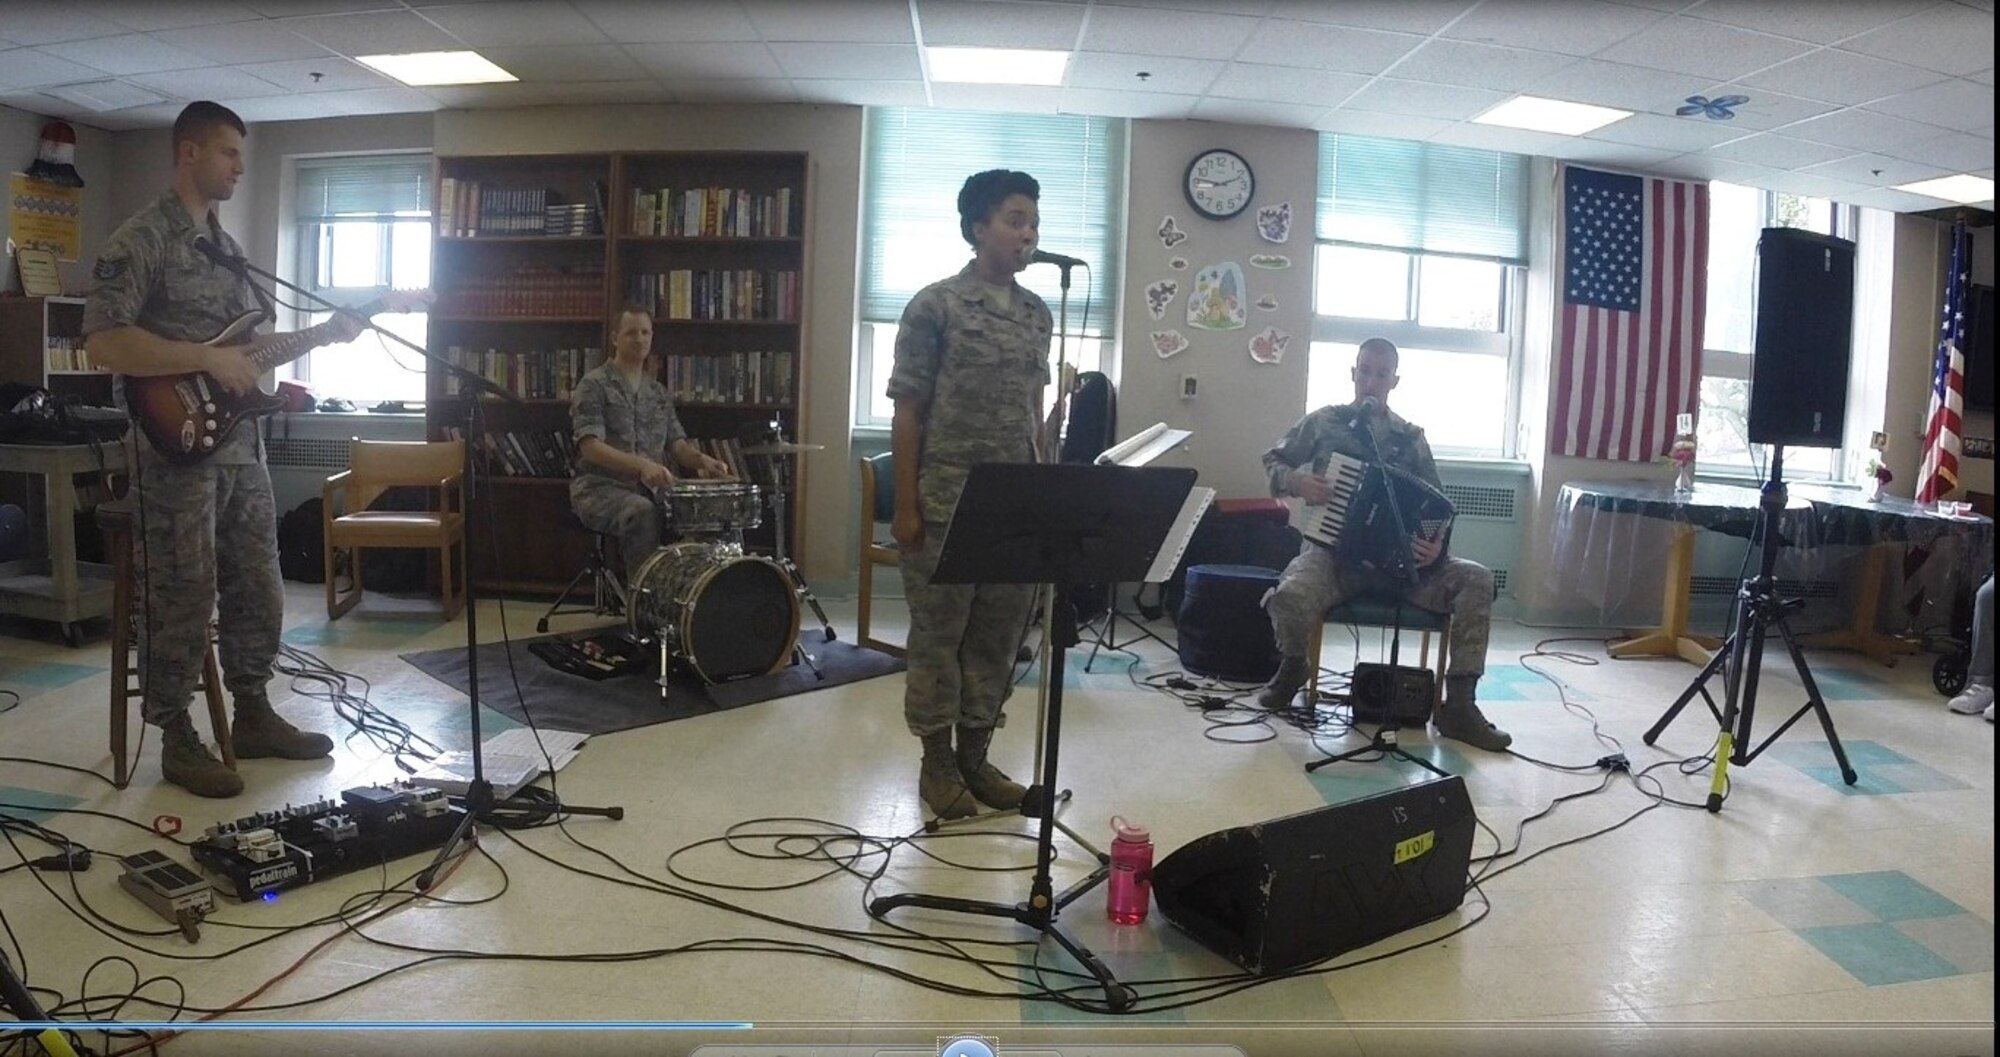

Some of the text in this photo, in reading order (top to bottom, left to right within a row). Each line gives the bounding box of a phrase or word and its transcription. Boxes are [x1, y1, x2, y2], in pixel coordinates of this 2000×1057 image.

[1205, 159, 1214, 169] 11
[1216, 157, 1226, 167] 12
[1198, 167, 1208, 177] 10
[1237, 169, 1244, 178] 2
[1240, 180, 1248, 191] 3
[1197, 191, 1204, 200] 8
[1235, 193, 1242, 201] 4
[1206, 198, 1213, 207] 7
[1216, 200, 1223, 211] 6
[1227, 199, 1235, 209] 5
[249, 865, 298, 889] pedaltrain
